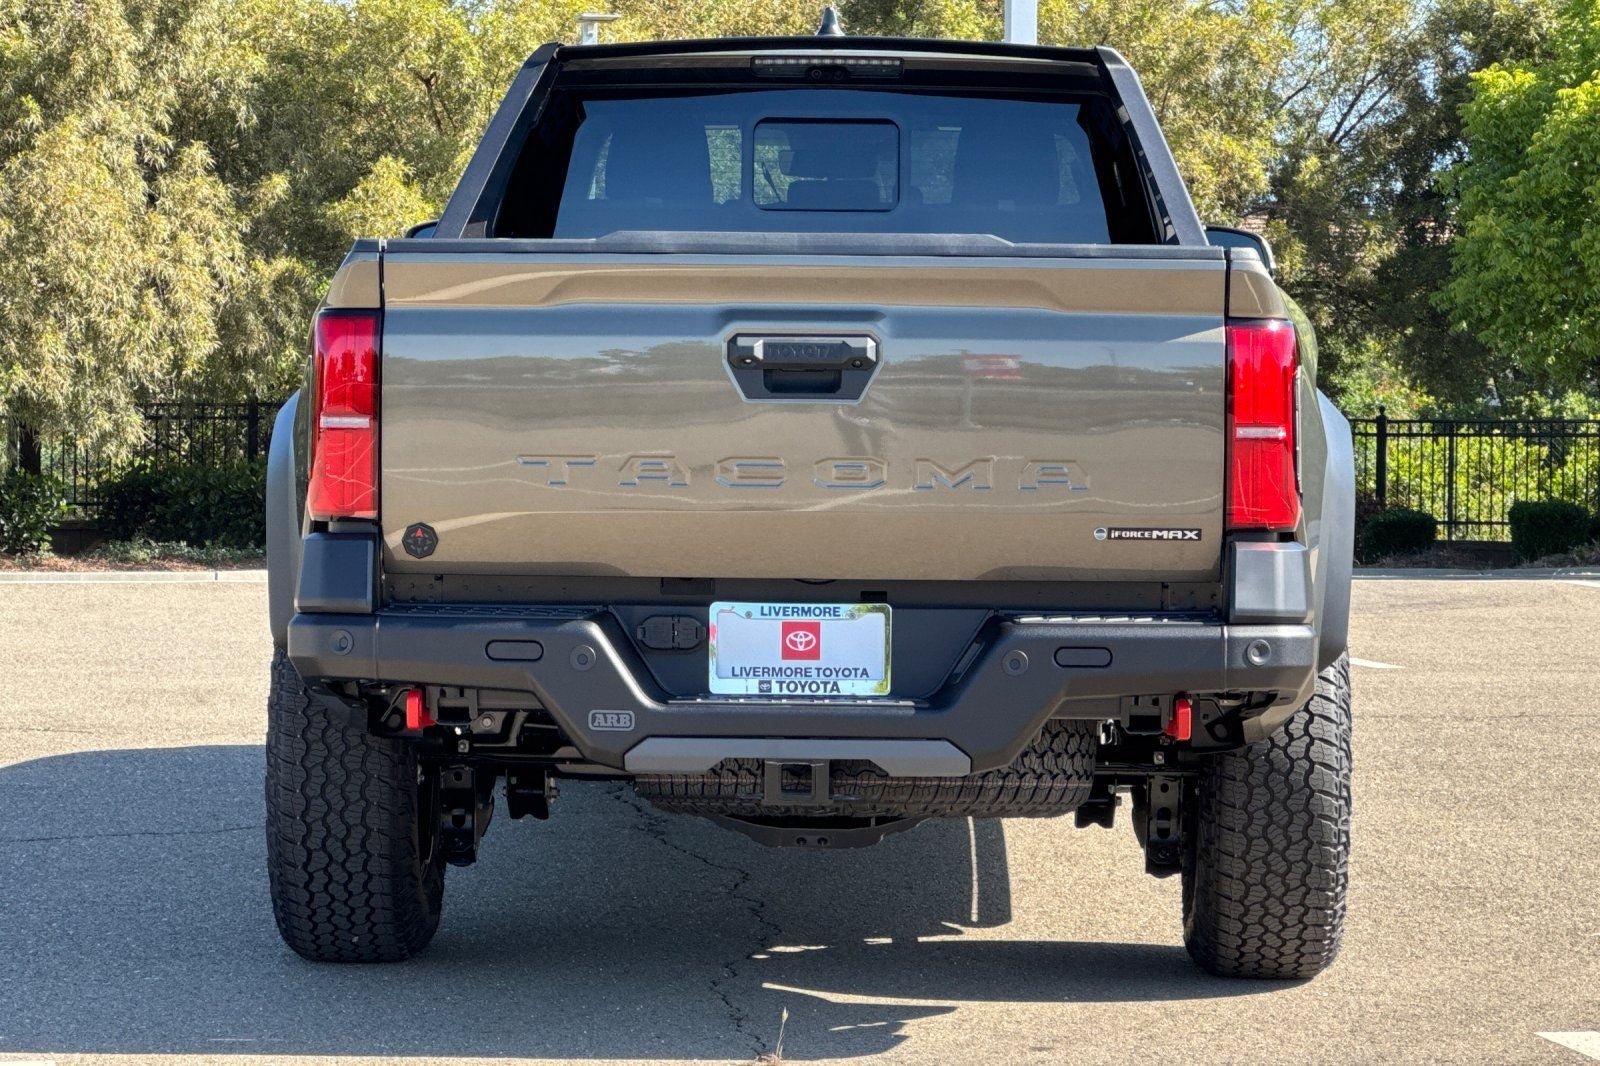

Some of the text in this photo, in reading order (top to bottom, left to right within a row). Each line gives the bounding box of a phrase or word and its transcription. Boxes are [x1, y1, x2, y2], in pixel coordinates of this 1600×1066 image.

[516, 453, 1093, 491] TACOMA
[760, 606, 841, 617] LIVERMORE
[731, 666, 870, 679] LIVERMORE TOYOTA
[775, 681, 841, 694] TOYOTA
[592, 712, 632, 728] ARB
